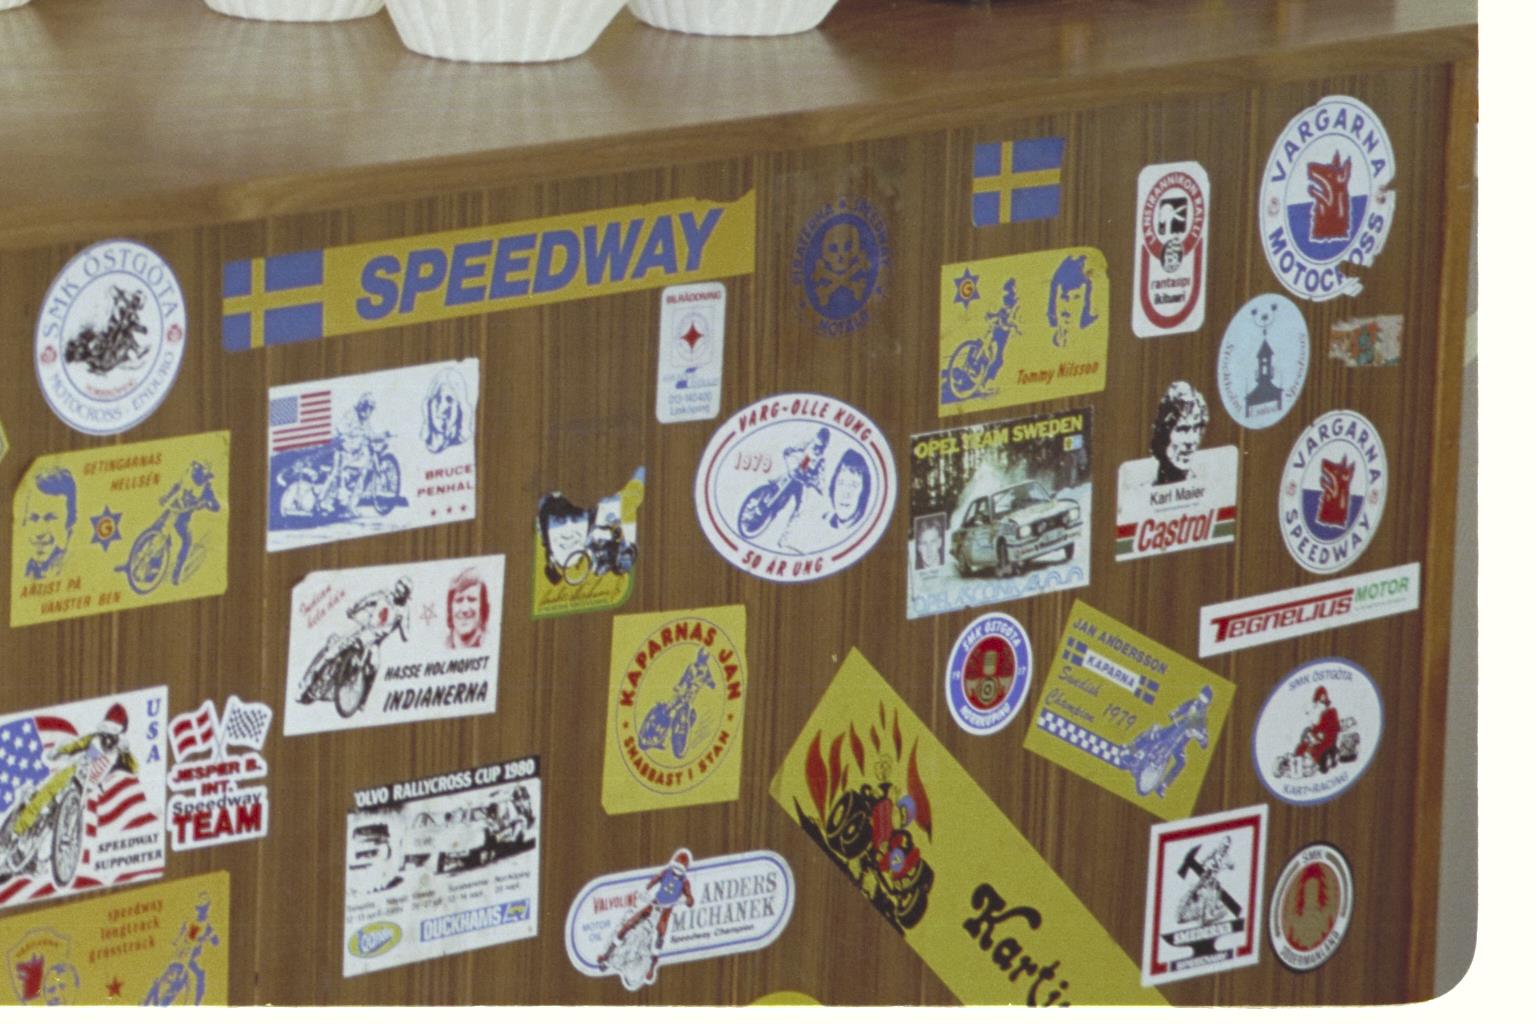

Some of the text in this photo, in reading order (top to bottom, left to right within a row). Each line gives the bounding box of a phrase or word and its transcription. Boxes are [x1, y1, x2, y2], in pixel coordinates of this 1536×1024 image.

[1271, 108, 1386, 182] VARGARNA
[354, 208, 725, 322] SPEEDWAY
[43, 277, 79, 337] SMK
[1017, 362, 1099, 386] Tommy Nilsson
[738, 399, 872, 441] VARG-OLLE KUNG
[914, 414, 1083, 460] OPEL TEAM SWEDEN
[82, 452, 162, 476] GETINGARNAS
[1293, 418, 1381, 484] VARGARNA
[425, 463, 472, 481] BRUCE
[1150, 486, 1205, 506] Karl Maier
[1137, 508, 1215, 553] Castrol
[1286, 508, 1370, 565] SPEEDWAY
[792, 557, 824, 577] UNG
[20, 579, 61, 599] ARTIST
[98, 591, 122, 607] BEN
[1354, 576, 1410, 602] MOTOR
[1072, 619, 1169, 675] JAN ANDERSSON
[383, 655, 491, 682] HASSE HOLMQVIST
[620, 622, 742, 707] KAPARNAS JAN
[1085, 655, 1137, 689] KAPARNA
[382, 680, 489, 714] INDIANERNA
[1288, 675, 1311, 691] SMK
[146, 697, 161, 765] USA
[1102, 703, 1138, 731] 1979
[172, 761, 240, 784] JESPER
[624, 736, 684, 788] SNABBAST
[698, 729, 731, 775] STAN
[200, 780, 235, 797] INT.
[354, 757, 536, 808] OLVO RALLYCROSS CUP 1980
[172, 792, 263, 817] Speedway
[172, 803, 263, 844] TEAM
[94, 849, 163, 870] SUPPORTER
[98, 833, 160, 854] SPEEDWAY
[592, 871, 778, 914] VALVOLINE ANDERS
[107, 898, 164, 923] speedway
[423, 905, 503, 942] DUCKHAMS
[671, 895, 776, 933] MICHANEK
[670, 930, 712, 945] Speedway
[962, 883, 1071, 1007] Karti
